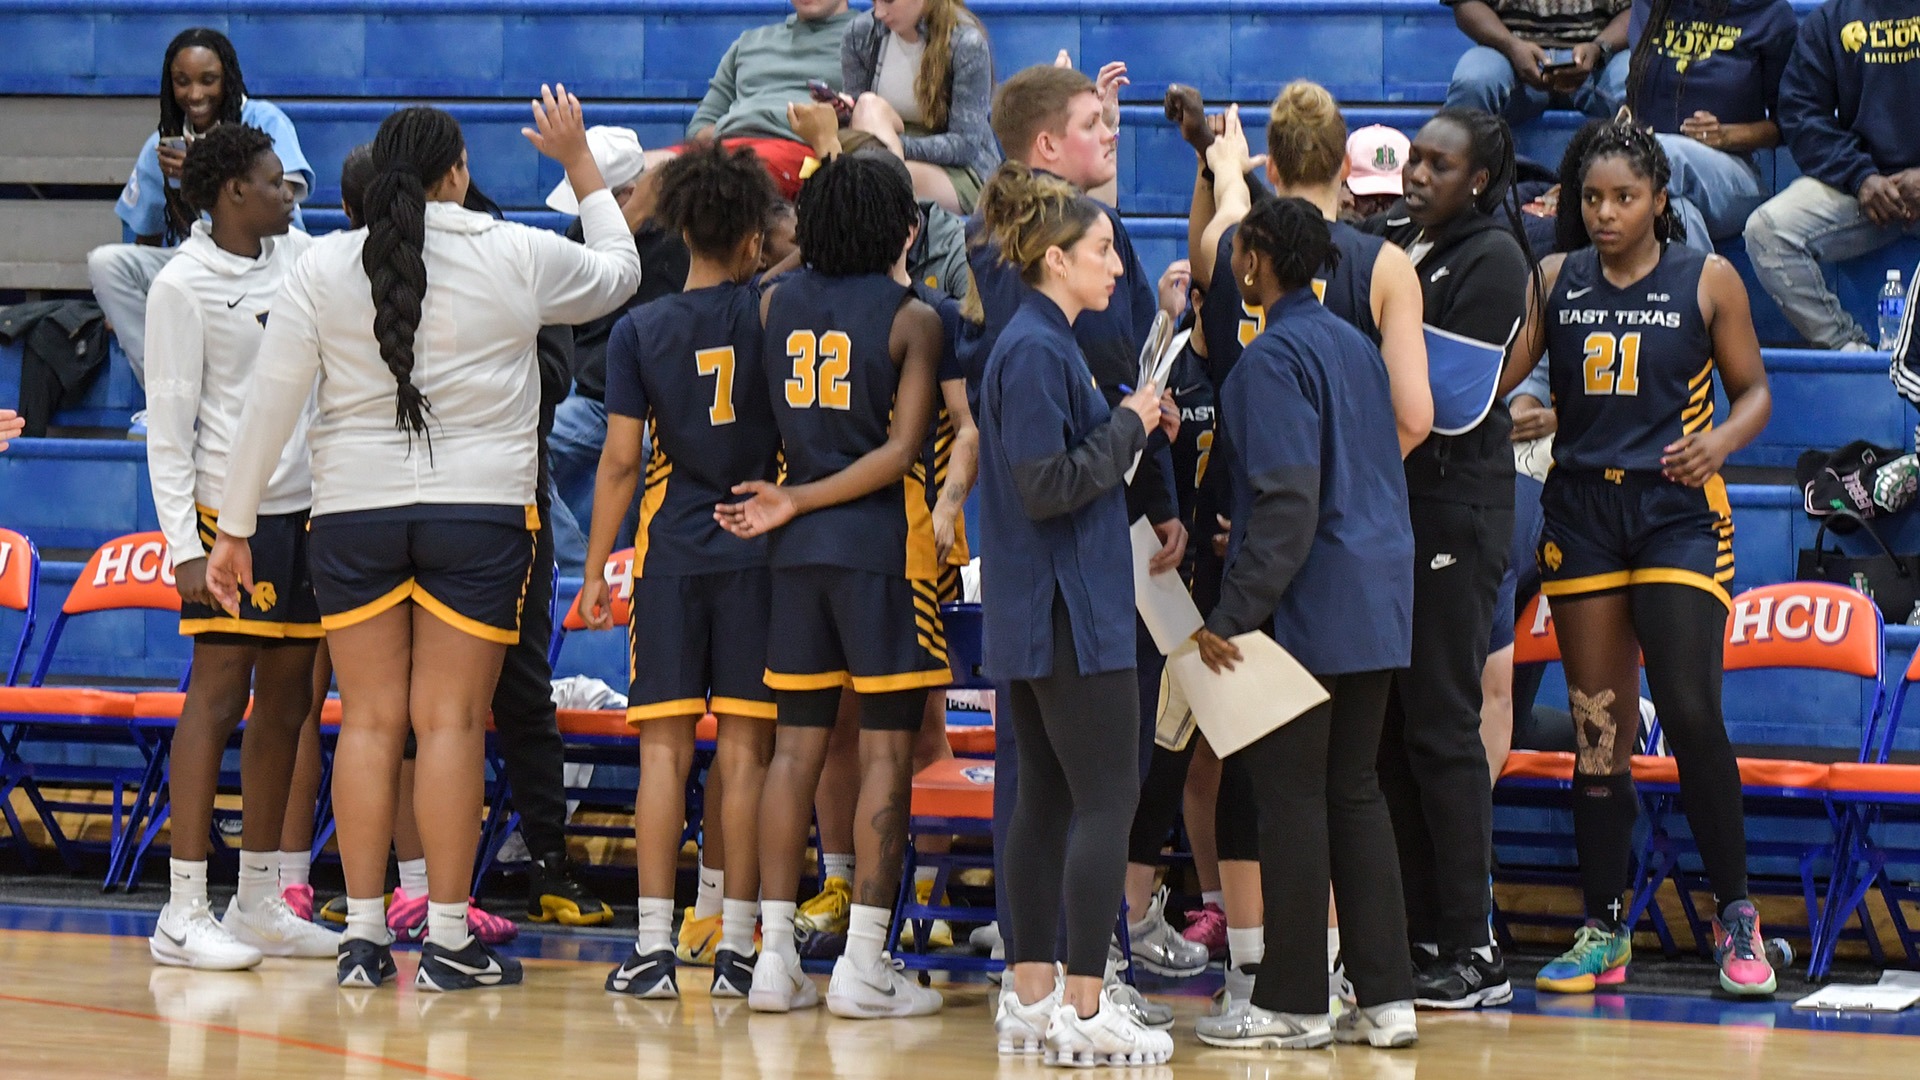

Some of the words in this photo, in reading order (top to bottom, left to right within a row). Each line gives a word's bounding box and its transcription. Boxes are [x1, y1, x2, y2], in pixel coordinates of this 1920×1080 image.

[1559, 309, 1609, 325] EAST
[1615, 309, 1681, 328] TEXAS
[694, 345, 737, 427] 7
[784, 329, 852, 411] 32
[1583, 331, 1642, 396] 21
[1729, 594, 1853, 645] HCU
